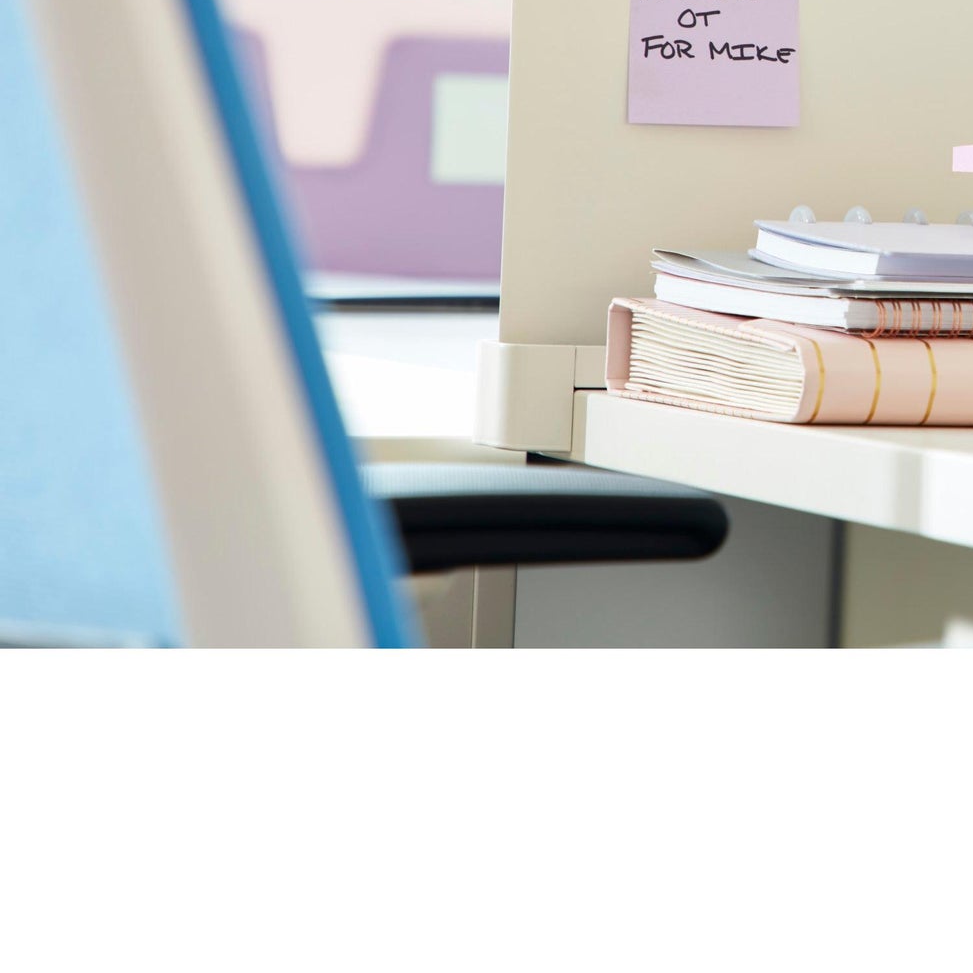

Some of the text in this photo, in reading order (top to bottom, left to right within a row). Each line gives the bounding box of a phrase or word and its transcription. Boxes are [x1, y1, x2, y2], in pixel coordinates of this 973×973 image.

[677, 8, 721, 29] OT
[640, 34, 797, 64] FOR MIKE
